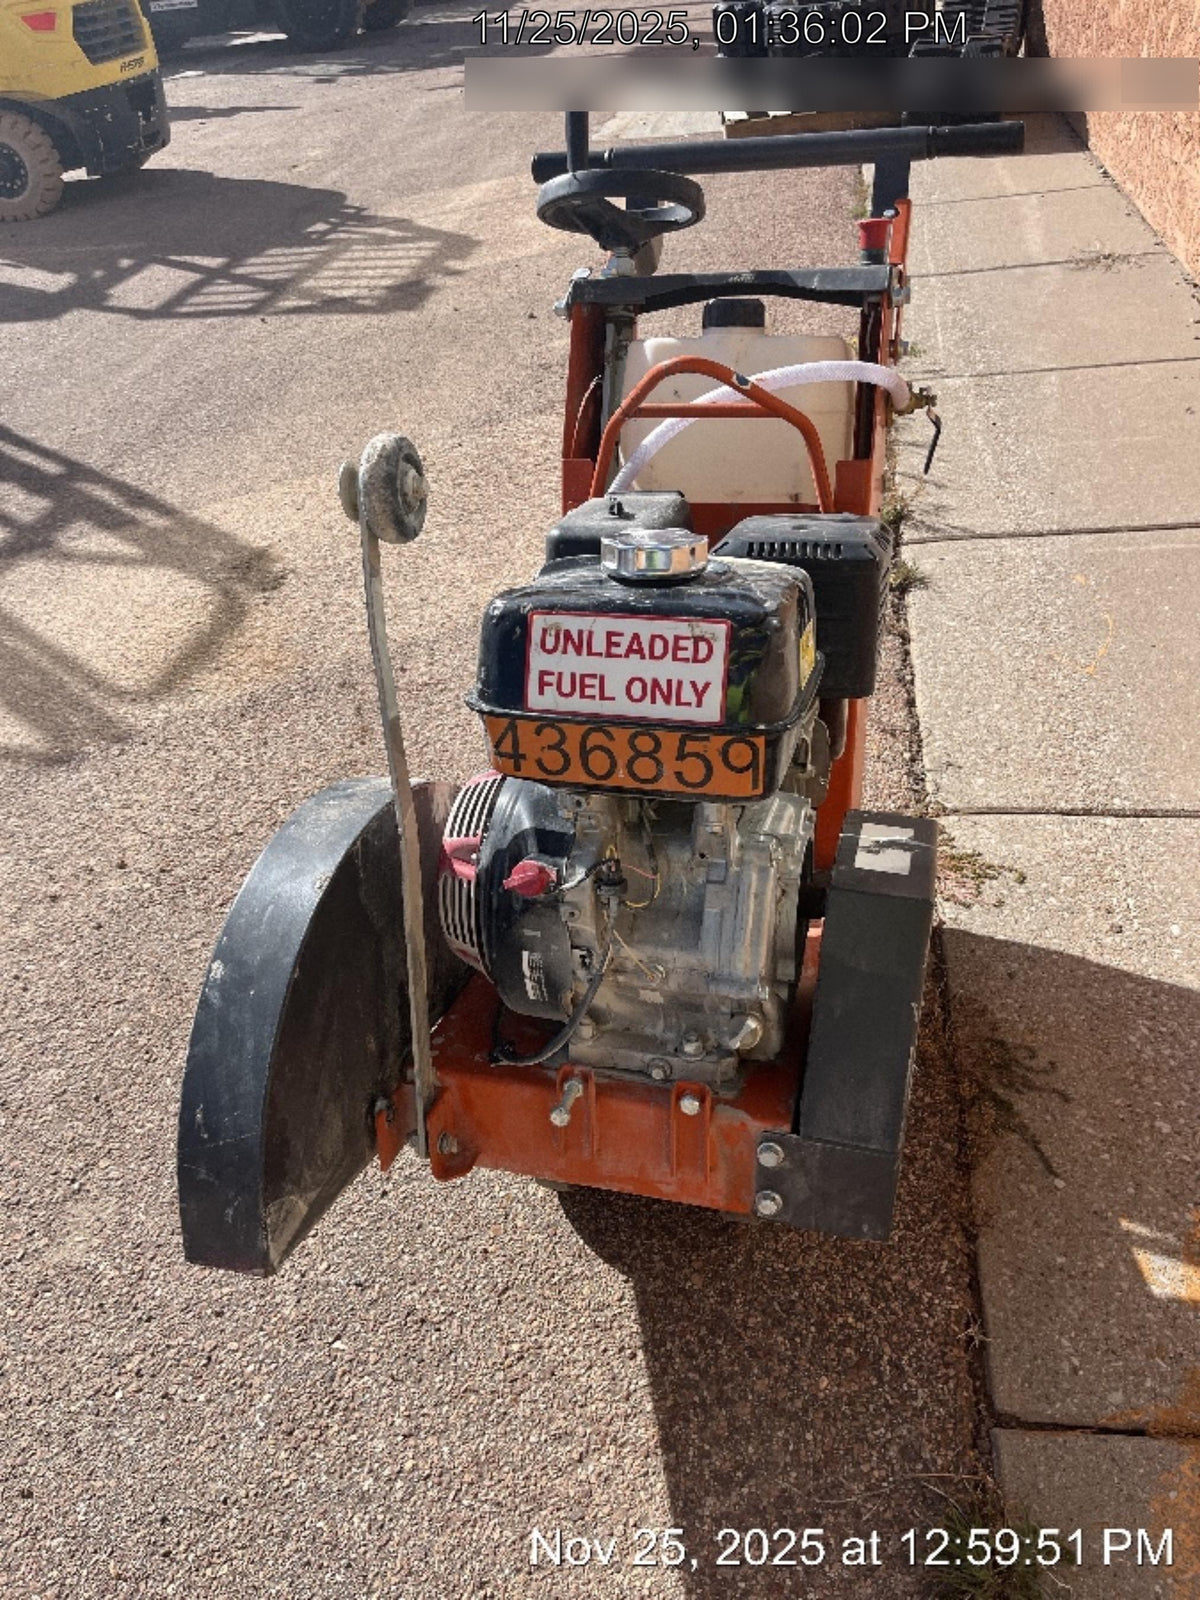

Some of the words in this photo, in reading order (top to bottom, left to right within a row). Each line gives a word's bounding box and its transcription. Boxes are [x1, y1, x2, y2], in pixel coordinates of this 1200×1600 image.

[540, 627, 714, 664] UNLEADED
[537, 669, 616, 701] FUEL
[625, 676, 712, 708] ONLY
[494, 718, 761, 791] 436859
